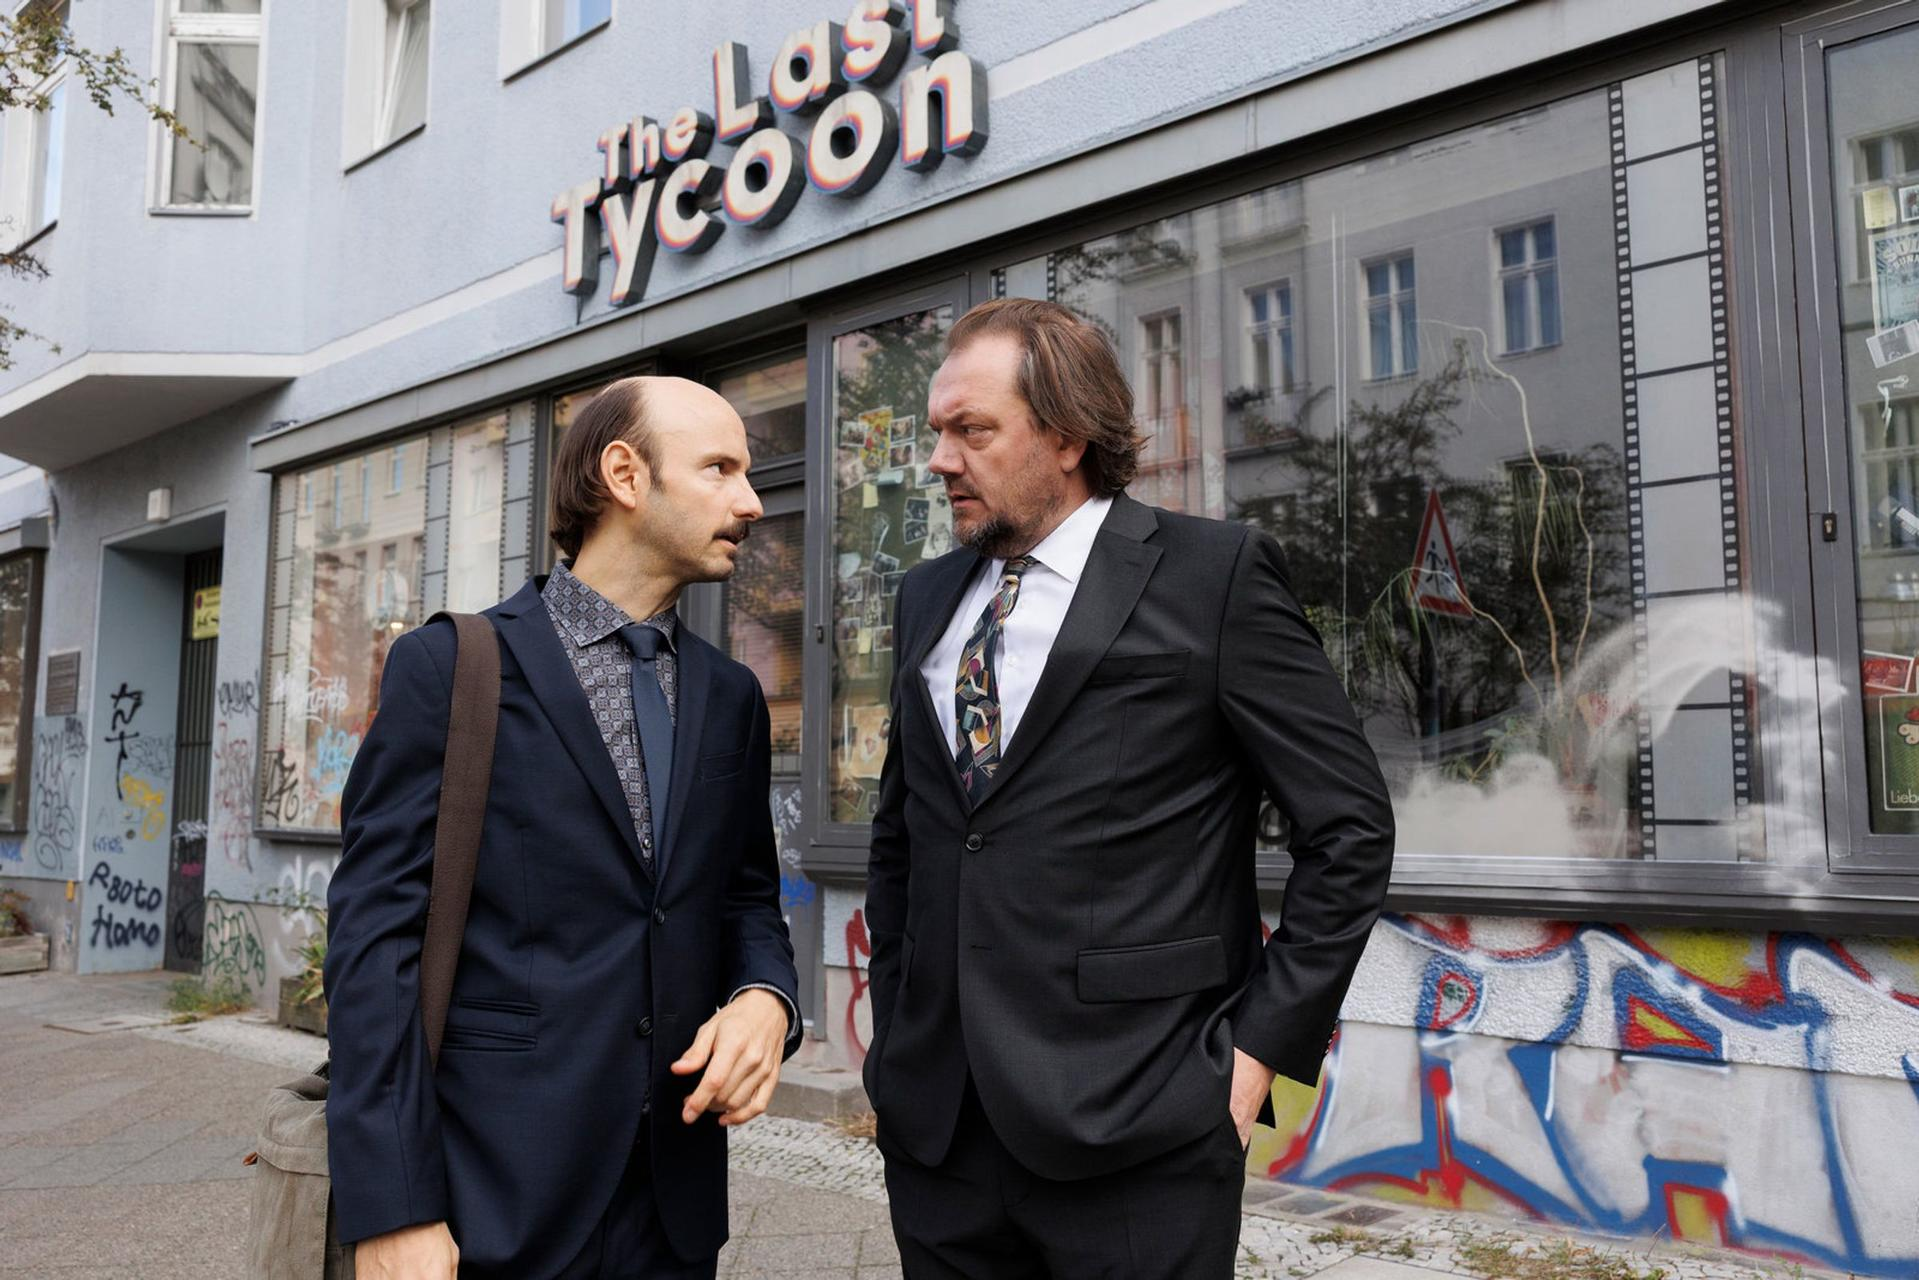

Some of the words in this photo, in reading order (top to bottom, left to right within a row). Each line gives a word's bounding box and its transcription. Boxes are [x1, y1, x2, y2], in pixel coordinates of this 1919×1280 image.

[551, 51, 989, 308] Tycoon
[598, 106, 714, 190] The
[1890, 788, 1919, 804] Lieb
